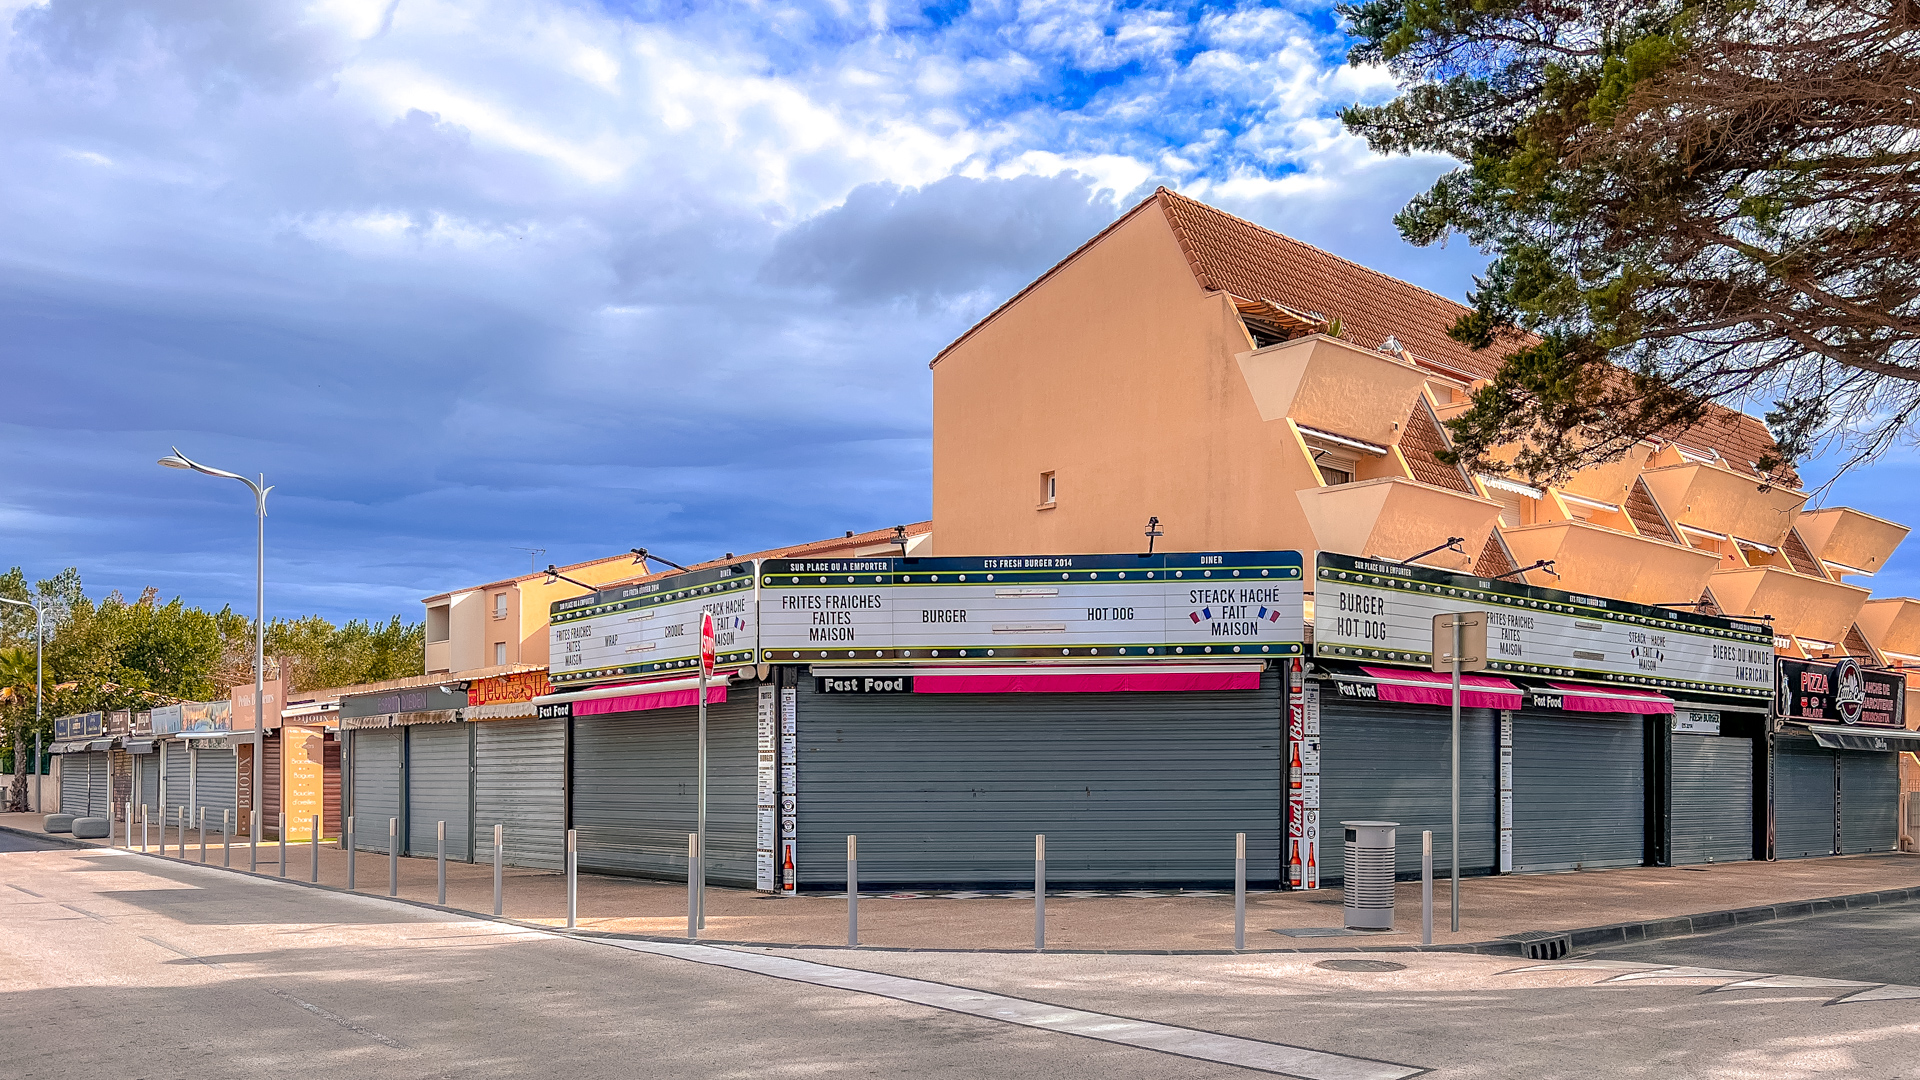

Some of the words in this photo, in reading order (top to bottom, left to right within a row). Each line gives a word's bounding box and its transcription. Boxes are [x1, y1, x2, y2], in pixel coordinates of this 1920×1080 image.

[790, 563, 804, 572] SUR
[806, 562, 828, 572] PLACE
[831, 562, 840, 571] OU
[842, 562, 848, 570] A
[850, 562, 888, 571] EMPORTER
[984, 560, 998, 568] ETS
[1000, 559, 1022, 568] FRESH
[1024, 558, 1052, 568] BURGER
[1054, 558, 1072, 567] 2014
[1200, 556, 1223, 564] DINER
[1364, 562, 1378, 572] PLACE
[1190, 590, 1235, 604] STEACK
[1240, 585, 1280, 603] HACHÉ
[725, 594, 746, 614] HACHÉ
[782, 596, 822, 610] FRITES
[826, 594, 881, 609] FRAICHES
[1339, 592, 1384, 616] BURGER
[812, 612, 851, 625] FAITES
[922, 610, 967, 623] BURGER
[1087, 608, 1108, 621] HOT
[1112, 607, 1134, 620] DOG
[1222, 606, 1247, 620] FAIT
[717, 616, 730, 631] FAIT
[1337, 616, 1360, 638] HOT
[1364, 620, 1386, 640] DOG
[1487, 612, 1506, 626] FRITES
[1507, 614, 1534, 630] FRAICHES
[556, 629, 570, 642] FRITES
[570, 625, 592, 640] FRAICHES
[664, 624, 684, 638] CROQUE
[809, 627, 854, 642] MAISON
[1211, 622, 1258, 636] MAISON
[1502, 628, 1520, 642] FAITES
[604, 634, 618, 647] WRAP
[1628, 631, 1646, 645] STEACK
[566, 640, 581, 652] FAITES
[1500, 642, 1522, 656] MAISON
[1643, 647, 1652, 658] FAIT
[564, 654, 582, 667] MAISON
[1713, 644, 1735, 661] BIERES
[1738, 648, 1745, 662] DU
[1748, 649, 1769, 665] MONDE
[1638, 658, 1657, 671] MAISON
[1736, 666, 1768, 682] AMERICAIN
[825, 678, 858, 692] Fast
[864, 678, 903, 692] Food
[1338, 682, 1356, 696] Fast
[1356, 684, 1376, 697] Food
[1801, 672, 1829, 694] PIZZA
[1534, 694, 1546, 706] Fast
[1546, 696, 1562, 708] Food
[539, 706, 552, 718] Fast
[554, 704, 568, 717] Food
[1290, 704, 1303, 740] Bud
[238, 758, 250, 808] BIJOUX
[294, 772, 314, 780] Bagues
[1289, 802, 1302, 836] Bud
